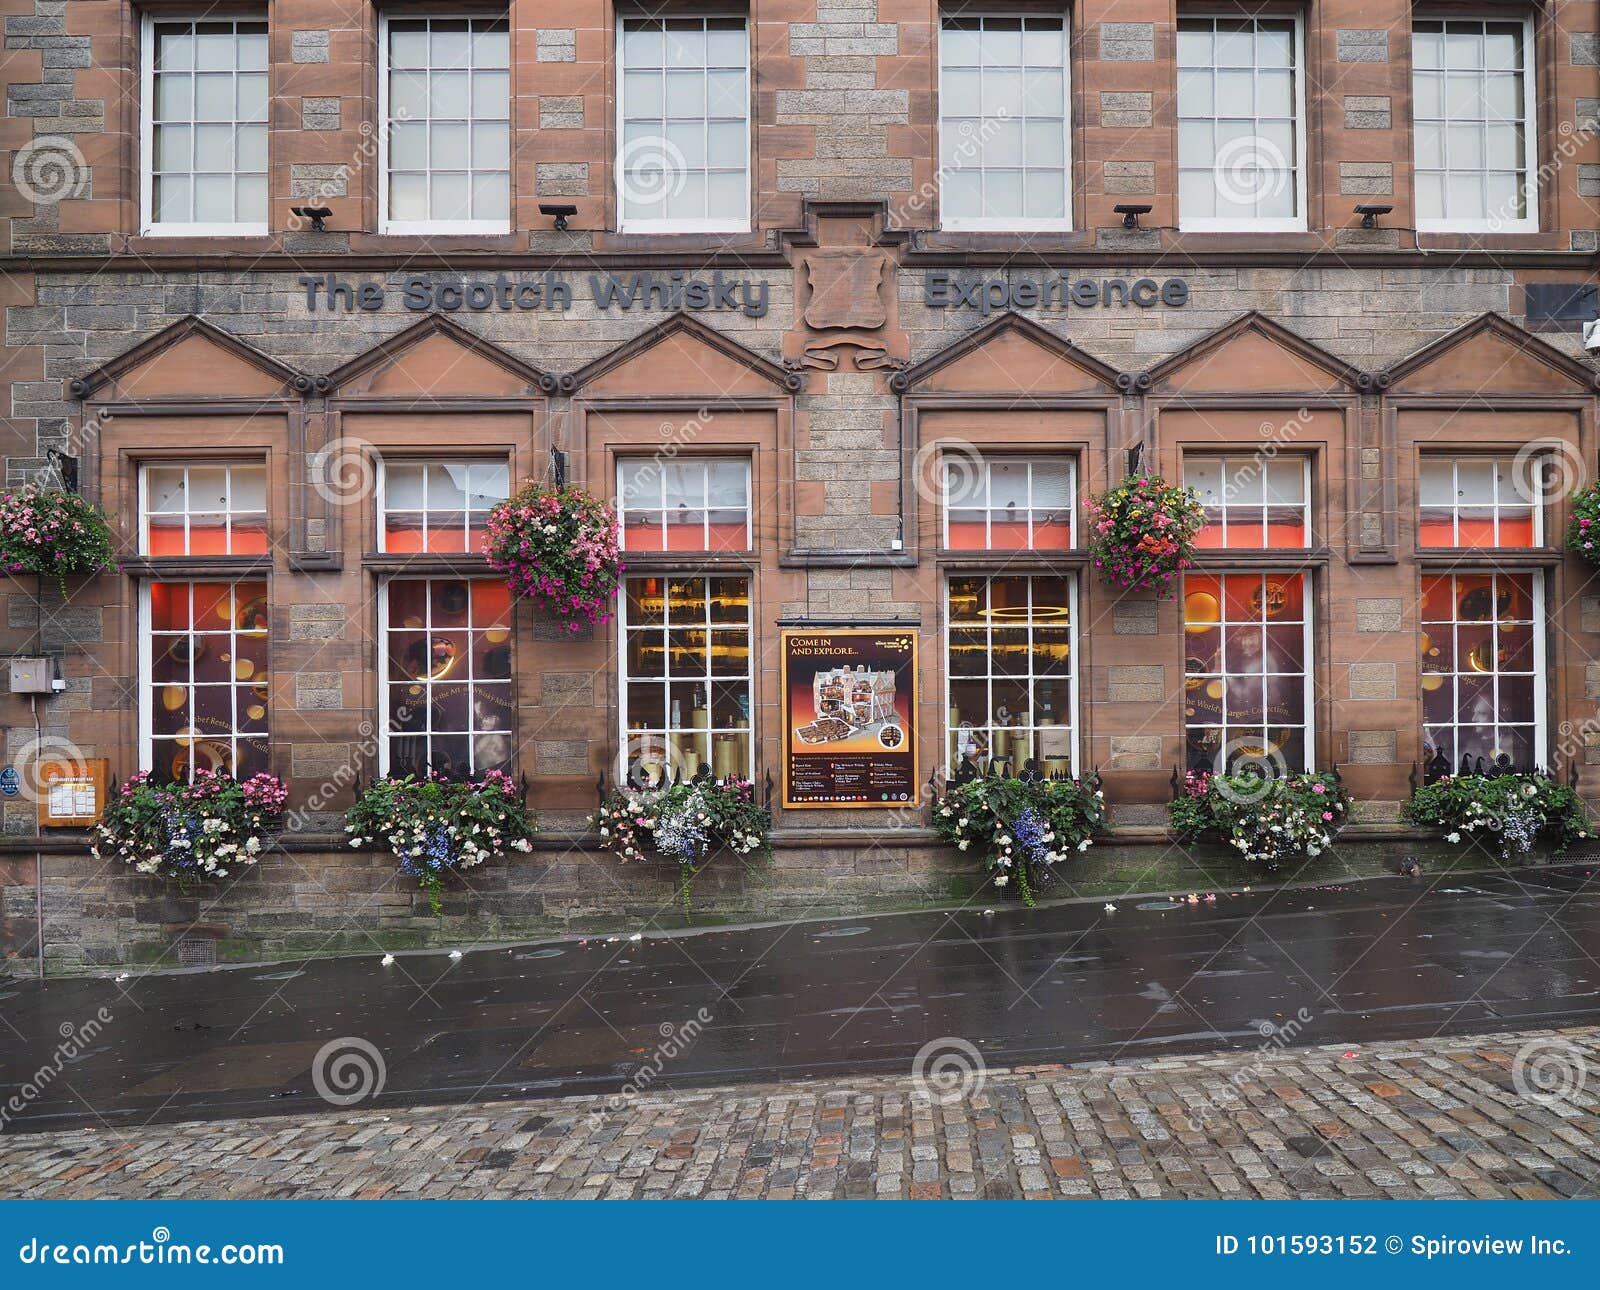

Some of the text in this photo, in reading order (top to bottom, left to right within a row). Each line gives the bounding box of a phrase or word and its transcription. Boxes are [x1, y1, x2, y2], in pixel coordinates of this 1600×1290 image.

[300, 269, 1189, 318] The Scotch Whisky Experience
